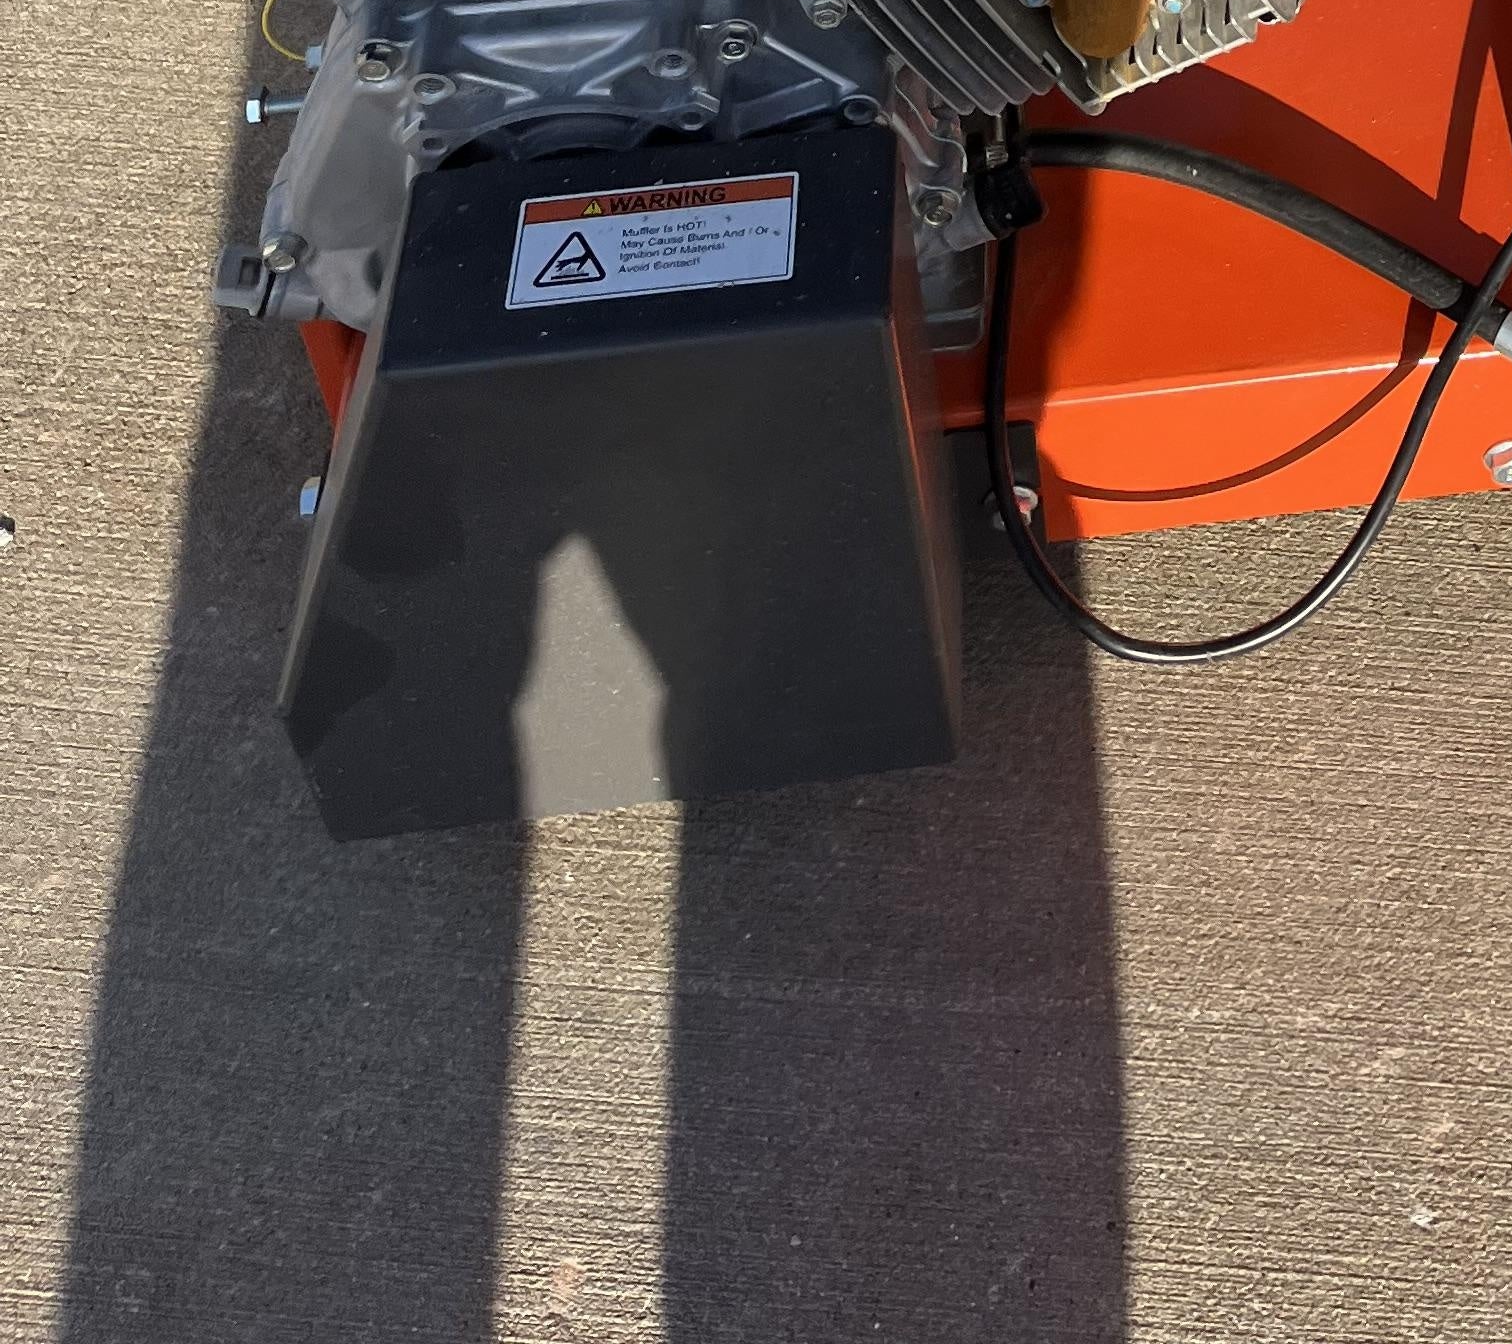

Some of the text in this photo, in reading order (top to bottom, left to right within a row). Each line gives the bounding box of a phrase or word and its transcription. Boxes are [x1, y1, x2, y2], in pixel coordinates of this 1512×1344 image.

[609, 186, 727, 214] WARNING
[620, 240, 645, 250] May
[648, 236, 684, 247] Cause
[723, 228, 746, 239] And
[755, 225, 770, 236] Or
